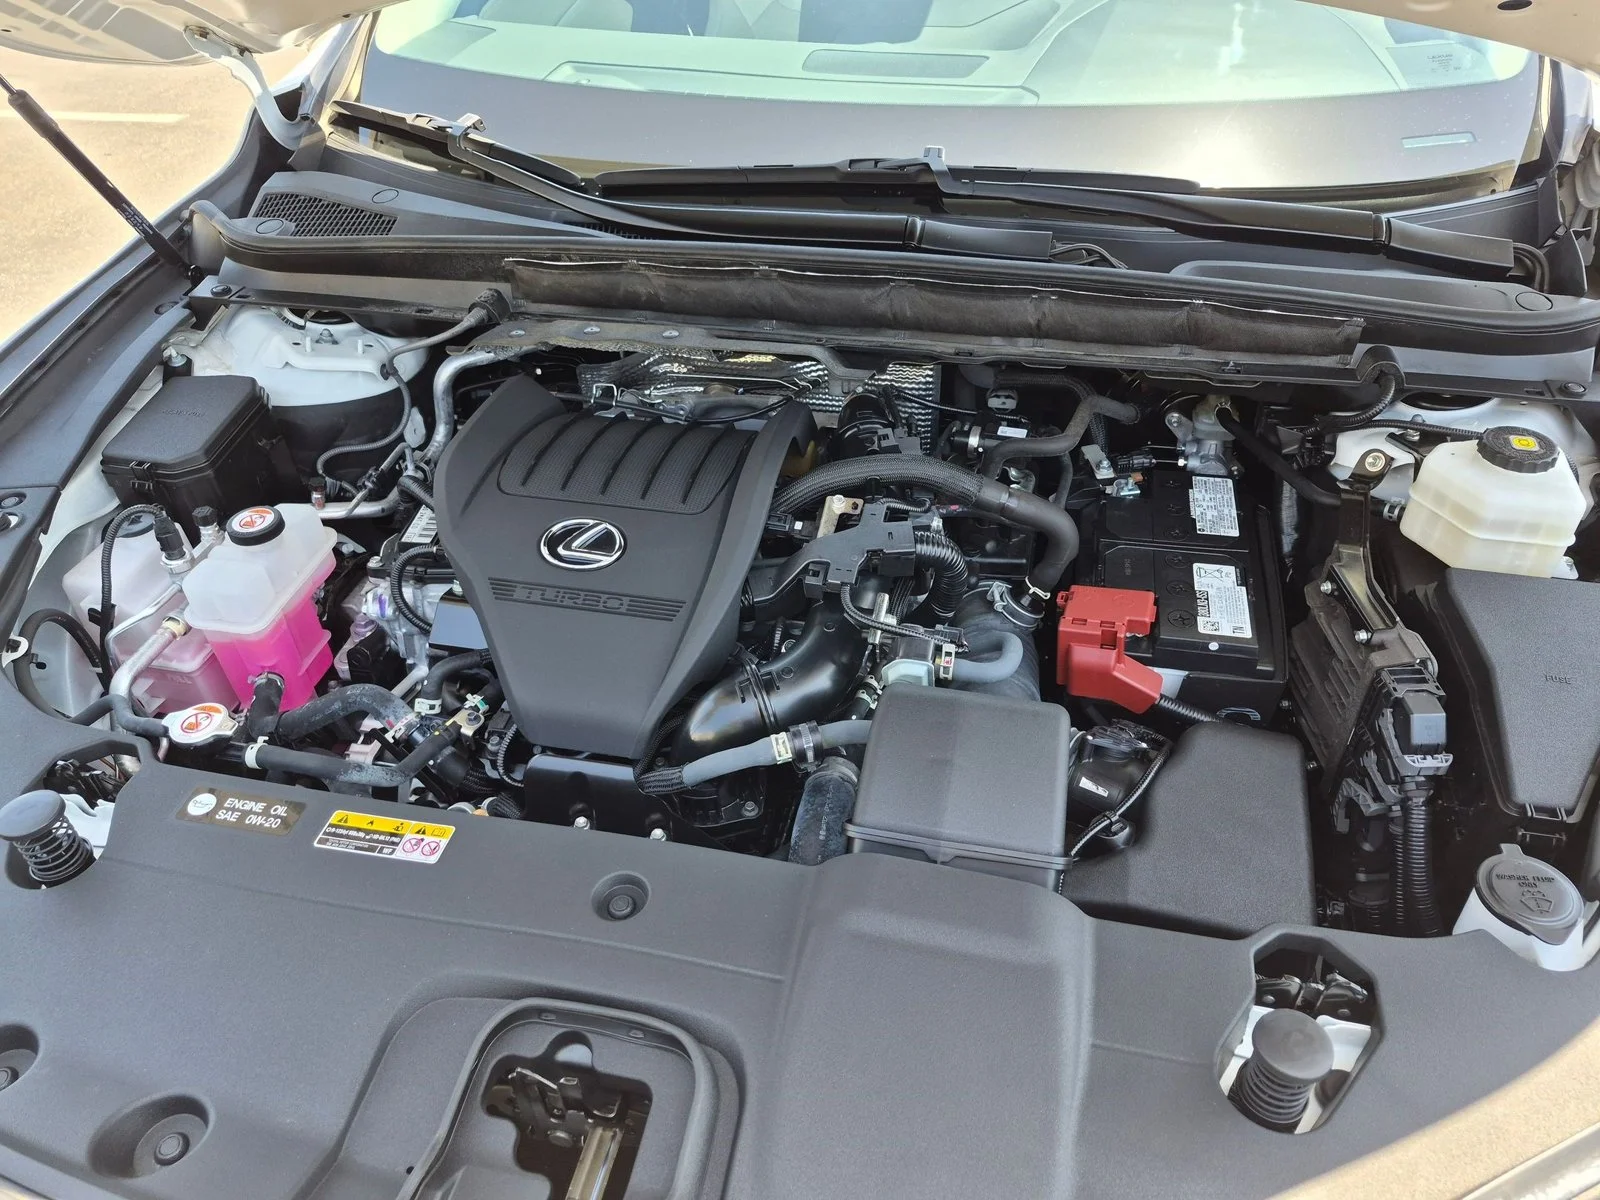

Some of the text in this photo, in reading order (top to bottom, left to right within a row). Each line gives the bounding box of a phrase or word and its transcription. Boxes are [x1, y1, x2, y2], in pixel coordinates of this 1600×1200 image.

[519, 586, 625, 610] TURBO
[1544, 674, 1572, 684] FUSE
[223, 798, 288, 816] ENGINE OIL
[215, 809, 281, 828] SAE 0W-20
[1495, 873, 1555, 883] WASHER FLUID
